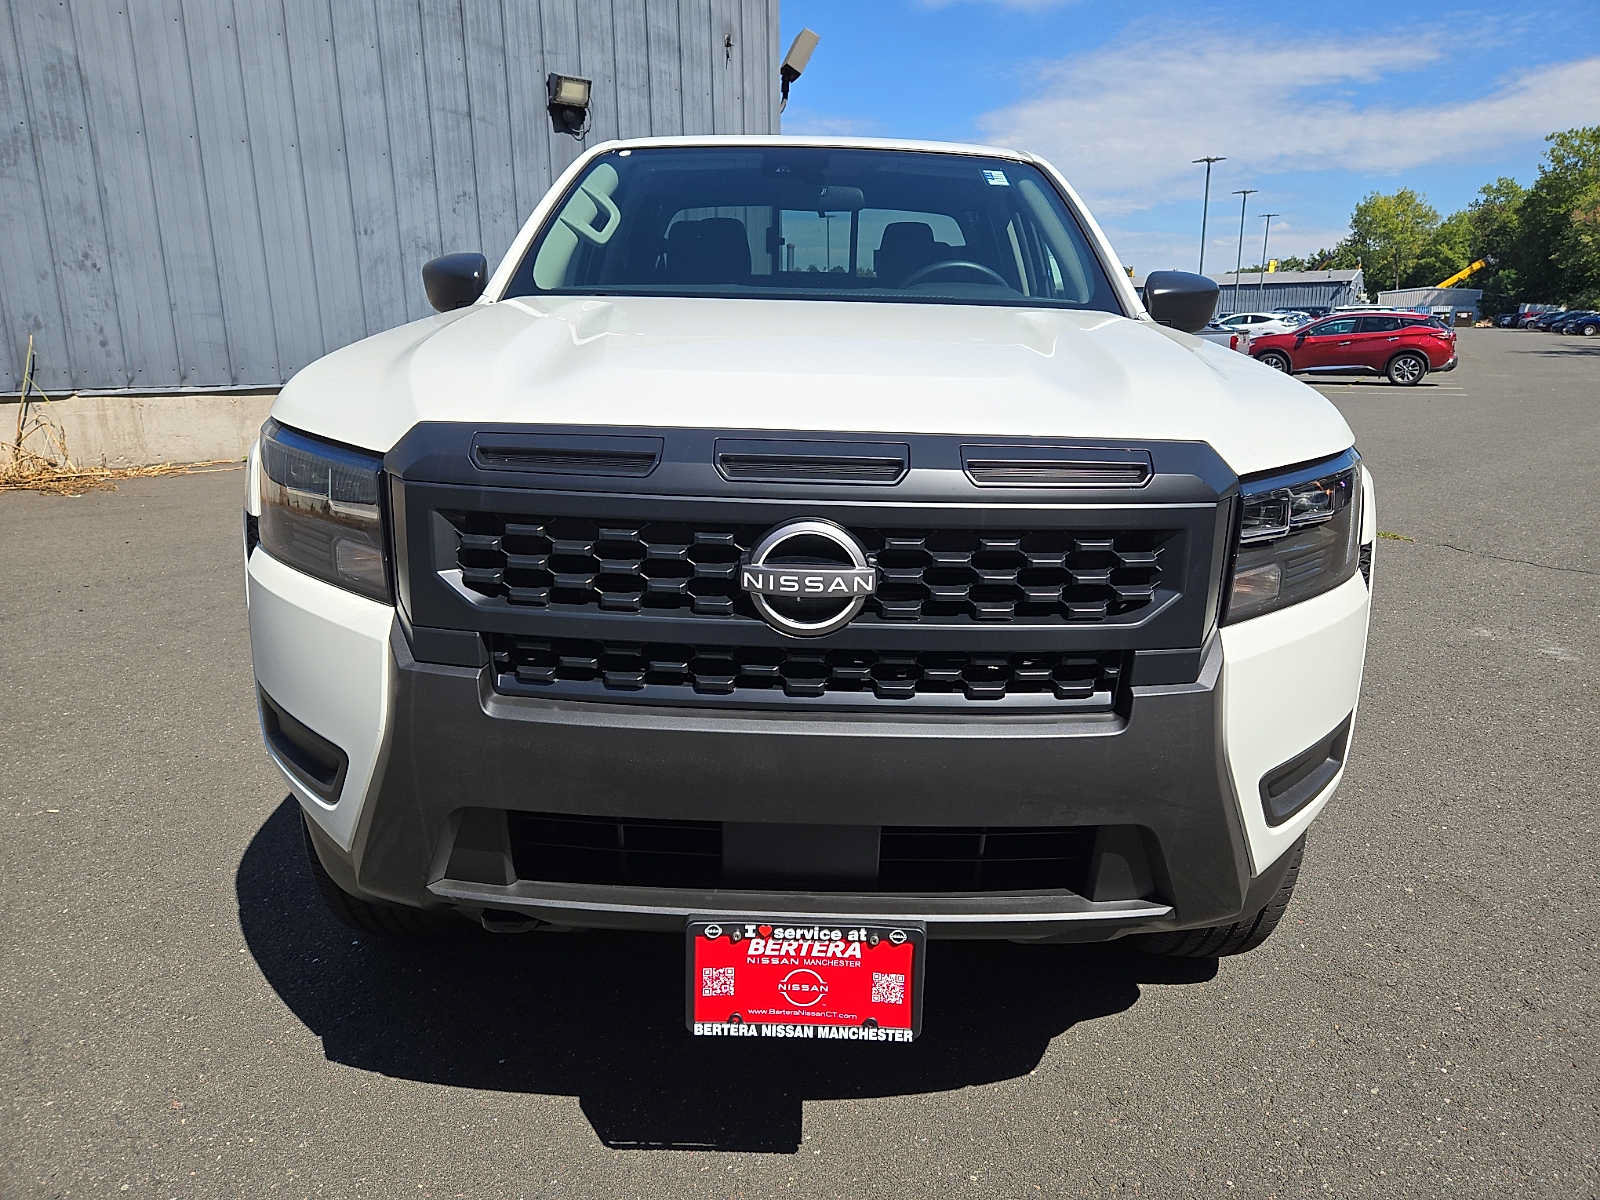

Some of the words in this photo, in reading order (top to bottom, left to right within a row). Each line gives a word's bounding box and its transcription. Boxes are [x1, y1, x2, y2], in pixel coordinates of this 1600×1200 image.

[743, 572, 873, 593] NISSAN
[744, 924, 756, 938] I
[773, 926, 842, 941] service
[847, 928, 868, 941] at
[747, 938, 862, 959] BERTERA
[747, 957, 799, 965] NISSAN
[803, 958, 861, 967] MANCHESTER
[778, 983, 829, 992] NISSAN
[747, 1008, 858, 1020] www.BerteraNissanCT.com
[693, 1023, 758, 1037] BERTERA
[761, 1024, 814, 1039] NISSAN
[817, 1026, 914, 1043] MANCHESTER
